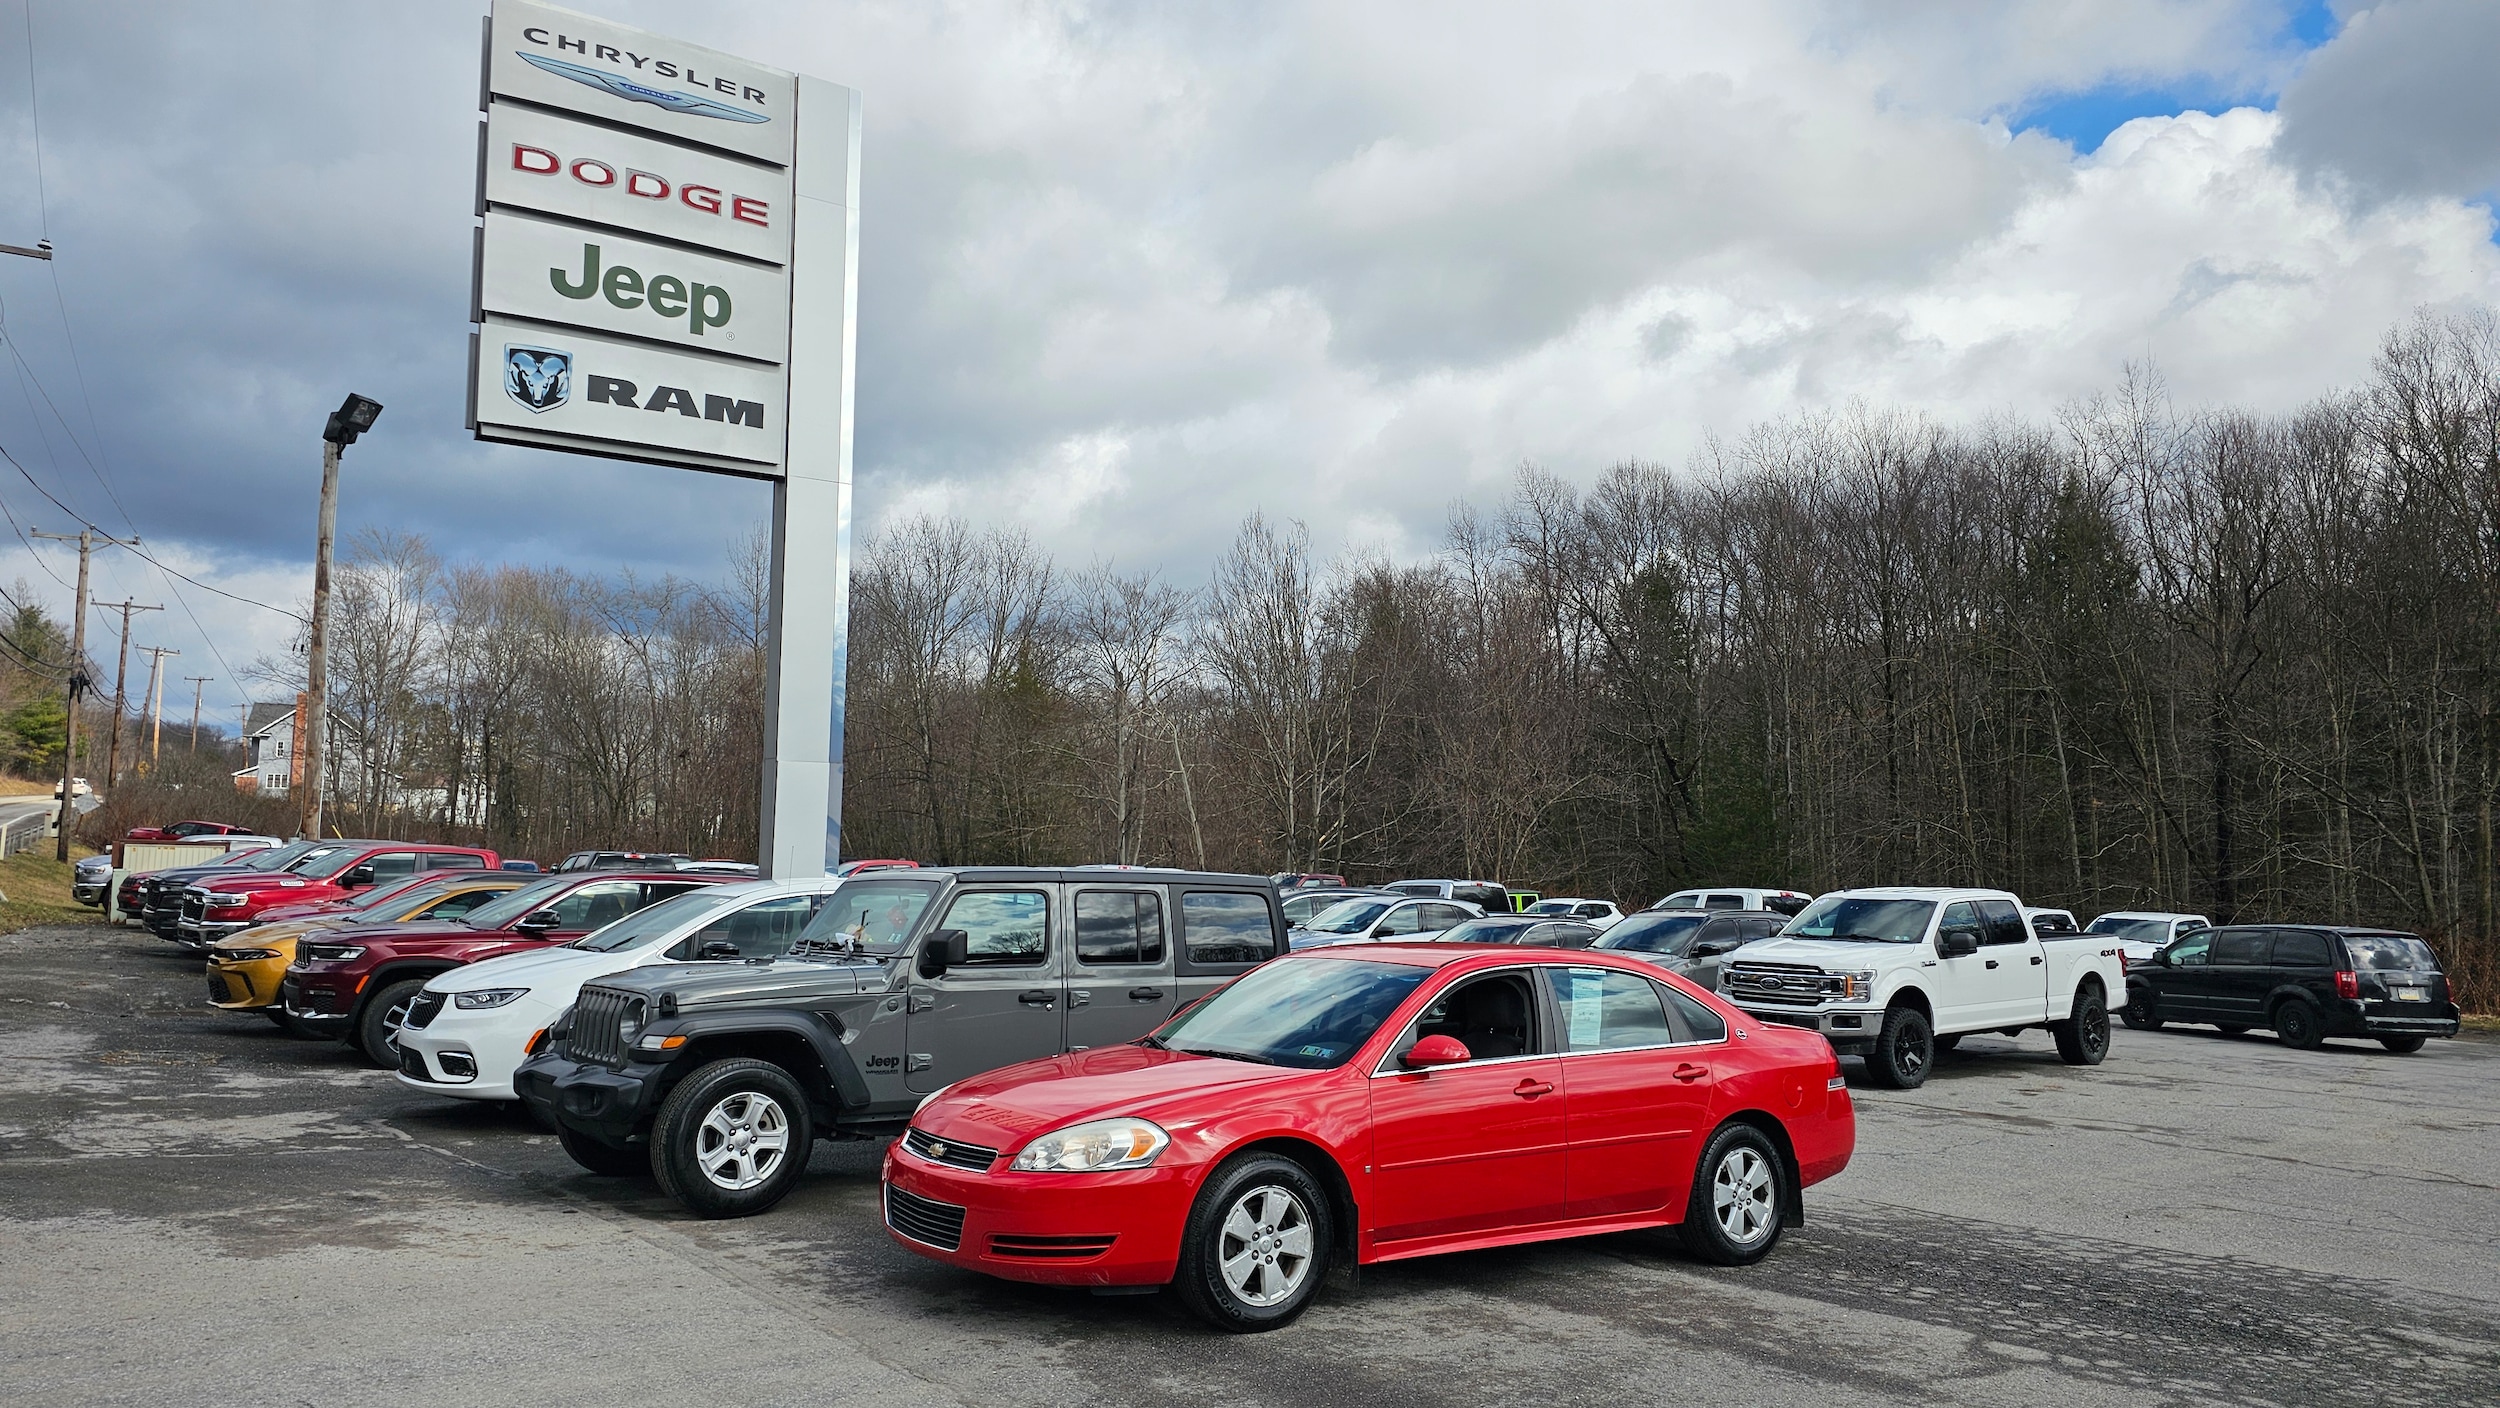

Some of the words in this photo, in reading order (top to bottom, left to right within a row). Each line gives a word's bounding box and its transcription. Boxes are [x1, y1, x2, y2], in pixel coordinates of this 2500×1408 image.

[523, 27, 766, 105] CHRYSLER
[511, 142, 769, 229] DODGE
[550, 243, 732, 336] Jeep
[587, 374, 764, 429] RAM
[865, 1054, 900, 1068] Jeep
